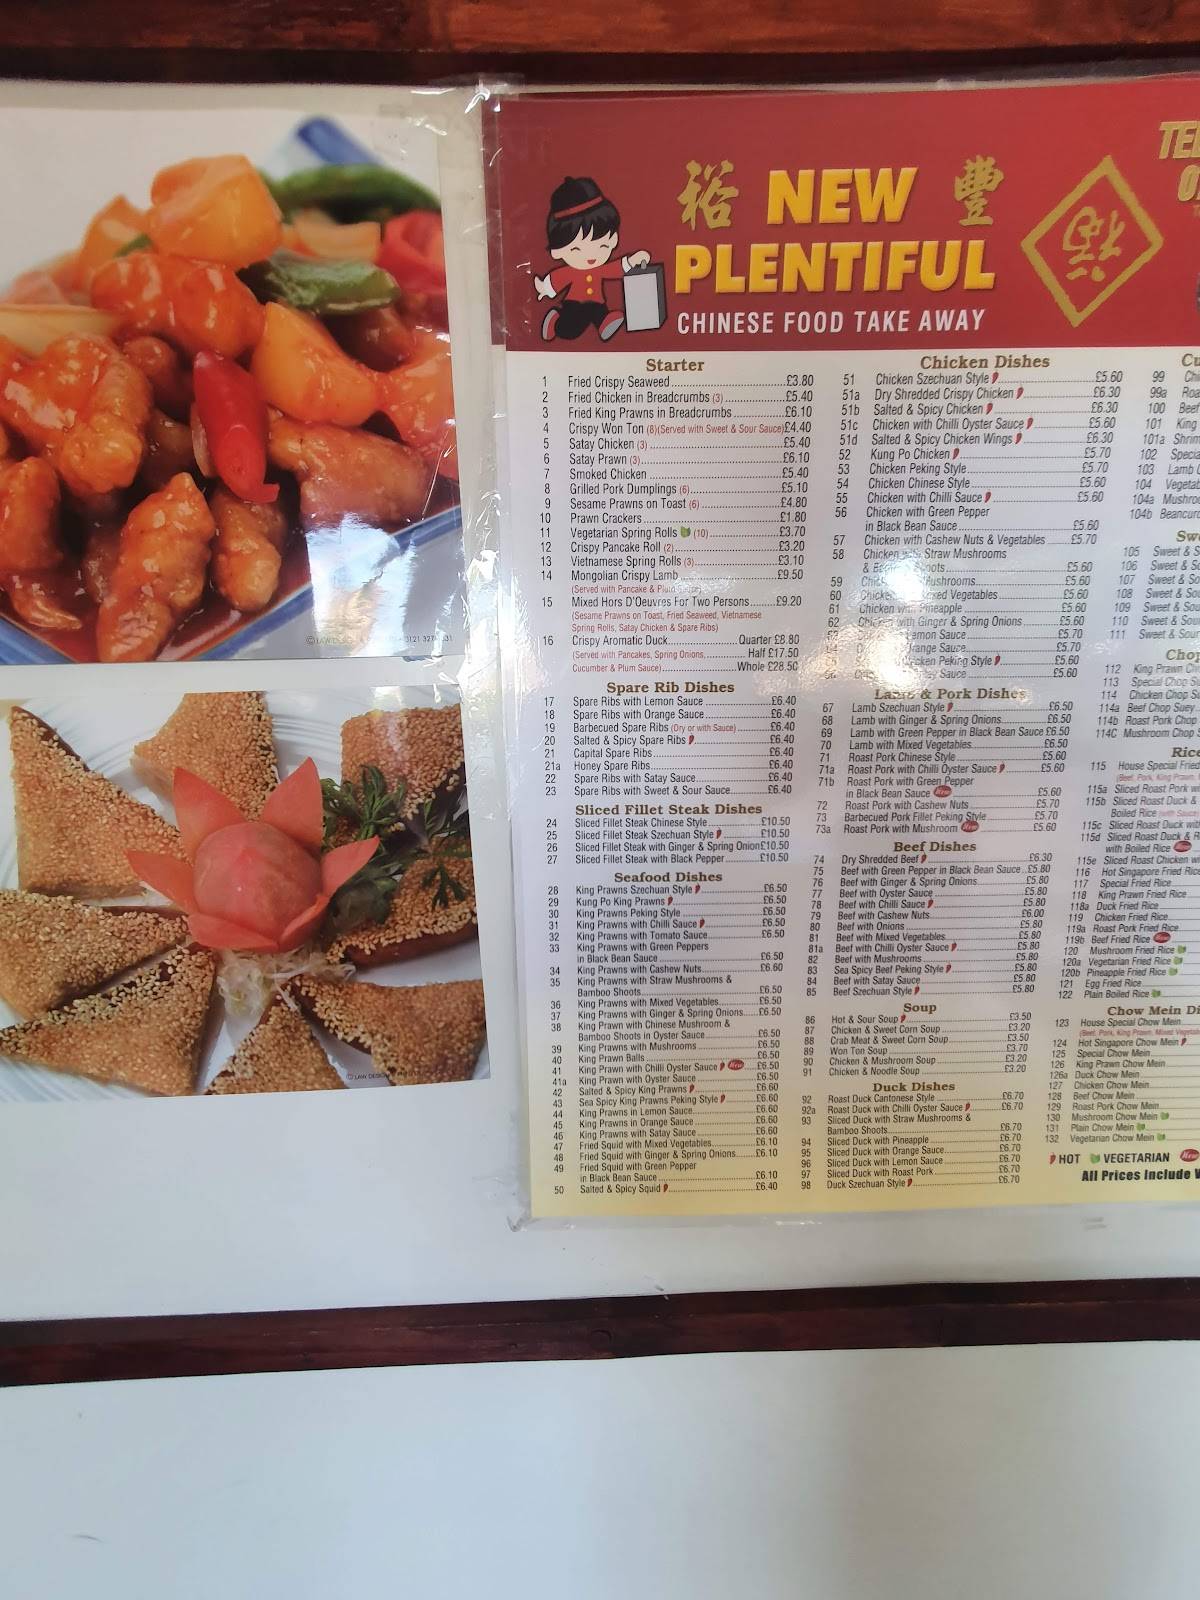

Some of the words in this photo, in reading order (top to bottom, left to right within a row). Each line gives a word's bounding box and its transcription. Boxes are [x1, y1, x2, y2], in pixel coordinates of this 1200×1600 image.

[677, 158, 740, 230] 裕
[766, 167, 919, 224] NEW
[954, 154, 1004, 227] 豐
[674, 241, 996, 294] PLENTIFUL
[677, 312, 775, 334] CHINESE
[784, 312, 846, 333] FOOD
[855, 311, 909, 332] TAKE
[918, 309, 985, 330] AWAY
[646, 359, 704, 371] Starter
[920, 355, 988, 370] Chicken
[995, 355, 1050, 369] Dishes
[542, 377, 547, 386] 1
[568, 376, 592, 388] Fried
[594, 376, 624, 390] Crispy
[628, 376, 670, 388] Seaweed
[786, 375, 813, 386] £3.80
[843, 374, 855, 385] 51
[876, 373, 914, 386] Chicken
[917, 372, 964, 385] Szechuan
[967, 372, 989, 387] Style
[1095, 371, 1123, 383] £5.60
[542, 392, 548, 402] 2
[568, 392, 592, 403] Fried
[595, 392, 632, 403] Chicken
[635, 392, 643, 402] in
[647, 391, 710, 402] Breadcrumbs
[786, 391, 812, 402] £5.40
[544, 439, 549, 448] 5
[569, 438, 594, 450] Satay
[598, 438, 634, 449] Chicken
[784, 438, 810, 448] £5.40
[544, 470, 550, 479] 7
[570, 469, 607, 480] Smoked
[610, 469, 646, 480] Chicken
[782, 468, 809, 478] £5.40
[838, 464, 850, 474] 53
[869, 462, 904, 475] Chicken
[906, 462, 940, 477] Peking
[943, 462, 966, 476] Style
[1082, 462, 1109, 474] £5.70
[544, 484, 550, 494] 8
[570, 484, 599, 494] Grilled
[602, 484, 624, 494] Pork
[627, 484, 676, 496] Dumplings
[782, 482, 808, 493] £5.10
[545, 499, 550, 509] 9
[571, 498, 606, 510] Sesame
[609, 498, 643, 509] Prawns
[646, 500, 658, 509] on
[661, 498, 686, 509] Toast
[781, 498, 807, 508] £4.80
[540, 514, 550, 523] 10
[571, 513, 599, 524] Prawn
[602, 513, 642, 524] Crackers
[780, 512, 806, 522] £1.80
[606, 682, 649, 695] Spare
[654, 682, 679, 693] Rib
[685, 682, 734, 693] Dishes
[920, 689, 931, 699] &
[937, 689, 972, 699] Pork
[977, 688, 1026, 699] Dishes
[544, 697, 554, 706] 17
[574, 696, 598, 708] Spare
[602, 696, 620, 706] Ribs
[623, 696, 641, 706] with
[644, 696, 674, 706] Lemon
[677, 696, 703, 706] Sauce
[772, 696, 796, 706] £6.40
[823, 703, 834, 712] 67
[852, 703, 876, 712] Lamb
[879, 702, 921, 712] Szechuan
[923, 702, 944, 713] Style
[1049, 701, 1073, 711] £6.50
[544, 749, 554, 758] 21
[574, 748, 602, 759] Capital
[606, 748, 630, 759] Spare
[634, 748, 652, 758] Ribs
[769, 747, 794, 757] £6.40
[576, 804, 620, 816] Sliced
[625, 804, 664, 815] Fillet
[669, 804, 710, 815] Steak
[715, 804, 762, 814] Dishes
[546, 819, 557, 828] 24
[575, 818, 600, 828] Sliced
[602, 818, 622, 828] Fillet
[625, 818, 648, 828] Steak
[651, 817, 684, 827] Chinese
[686, 817, 707, 828] Style
[761, 816, 790, 826] £10.50
[894, 842, 926, 852] Beef
[930, 841, 976, 851] Dishes
[814, 855, 824, 864] 74
[842, 855, 856, 865] Dry
[859, 855, 898, 864] Shredded
[900, 854, 918, 864] Beef
[1029, 853, 1052, 862] £6.30
[615, 872, 670, 882] Seafood
[676, 872, 722, 882] Dishes
[1074, 880, 1088, 888] 117
[1100, 879, 1129, 888] Special
[1130, 879, 1151, 887] Fried
[1154, 879, 1171, 887] Rice
[548, 886, 558, 895] 28
[576, 885, 594, 896] King
[597, 885, 628, 895] Prawns
[630, 884, 670, 894] Szechuan
[673, 884, 692, 896] Style
[764, 884, 787, 893] £6.50
[1086, 980, 1100, 989] Egg
[1124, 979, 1142, 987] Rice
[904, 1003, 936, 1014] Soup
[1108, 1007, 1144, 1015] Chow
[1150, 1006, 1180, 1015] Mein
[804, 1048, 814, 1056] 89
[830, 1047, 848, 1055] Won
[851, 1046, 865, 1055] Ton
[867, 1046, 887, 1056] Soup
[1006, 1044, 1028, 1052] £3.70
[873, 1082, 907, 1092] Duck
[912, 1082, 955, 1091] Dishes
[1059, 1154, 1080, 1164] HOT
[1104, 1153, 1169, 1162] VEGETARIAN
[1082, 1171, 1098, 1181] All
[1102, 1170, 1140, 1180] Prices
[1145, 1169, 1190, 1179] Include
[802, 1181, 811, 1189] 98
[827, 1180, 846, 1189] Duck
[848, 1179, 884, 1189] Szechuan
[887, 1179, 905, 1190] Style
[998, 1175, 1020, 1184] £6.70
[554, 1186, 564, 1194] 50
[580, 1184, 602, 1194] Salted
[605, 1184, 612, 1193] &
[614, 1184, 636, 1196] Spicy
[638, 1183, 660, 1195] Squid
[756, 1182, 778, 1192] £6.40
